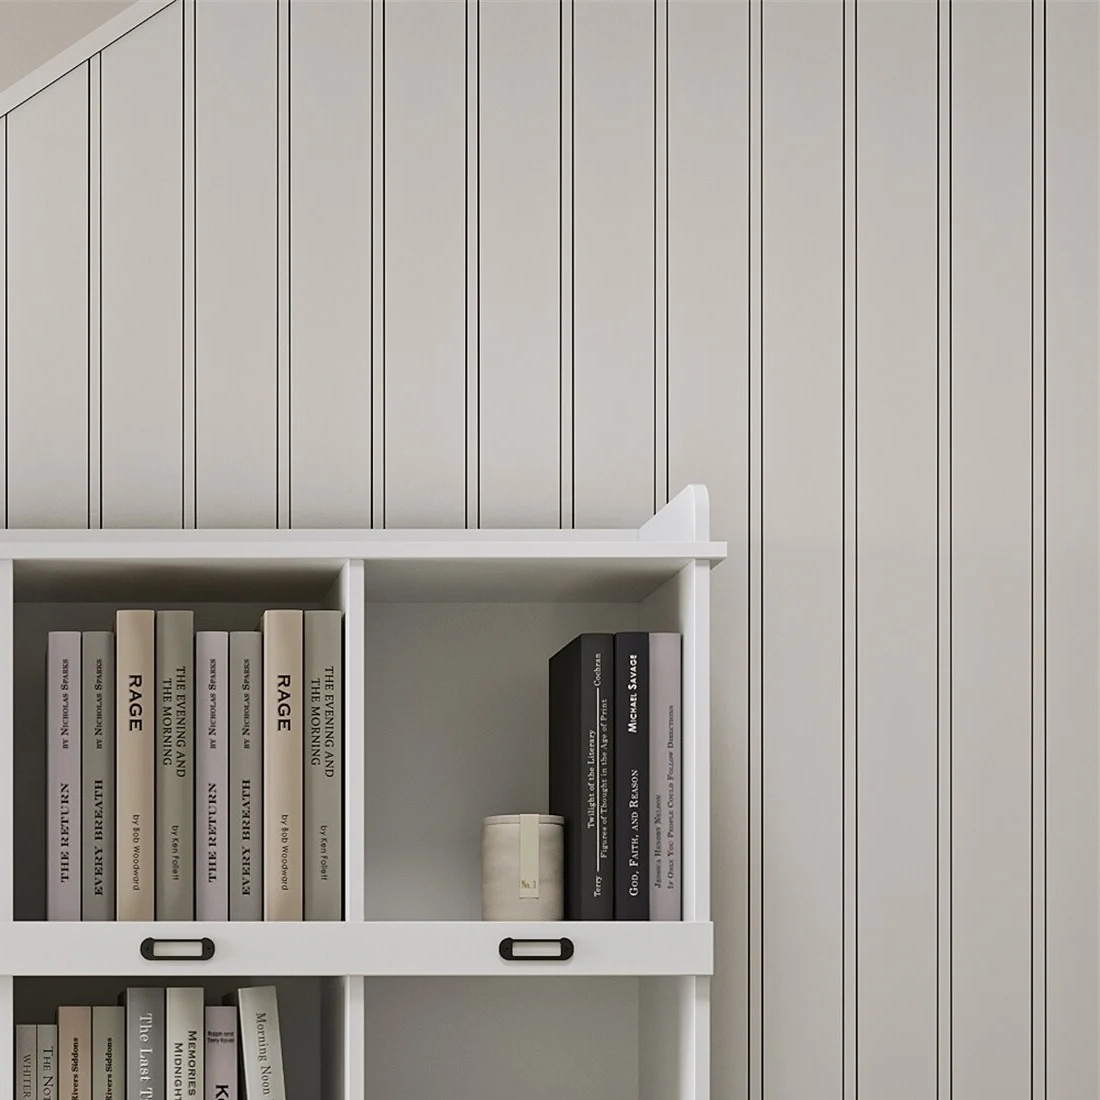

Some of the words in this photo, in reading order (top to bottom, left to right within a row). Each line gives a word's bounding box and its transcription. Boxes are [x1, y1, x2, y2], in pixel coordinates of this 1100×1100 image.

[163, 678, 172, 702] THE
[176, 666, 185, 690] THE
[129, 675, 142, 731] RAGE
[278, 675, 291, 731] RAGE
[163, 706, 172, 765] MORNING
[175, 695, 186, 747] EVENING
[176, 751, 186, 777] AND
[587, 730, 596, 764] Literary
[588, 782, 595, 791] of
[61, 783, 69, 846] RETURN
[94, 780, 103, 840] BREATH
[132, 815, 140, 825] by
[587, 793, 596, 828] Twilight
[171, 825, 179, 836] by
[61, 852, 69, 882] THE
[94, 846, 103, 895] EVERY
[172, 856, 180, 880] Follett
